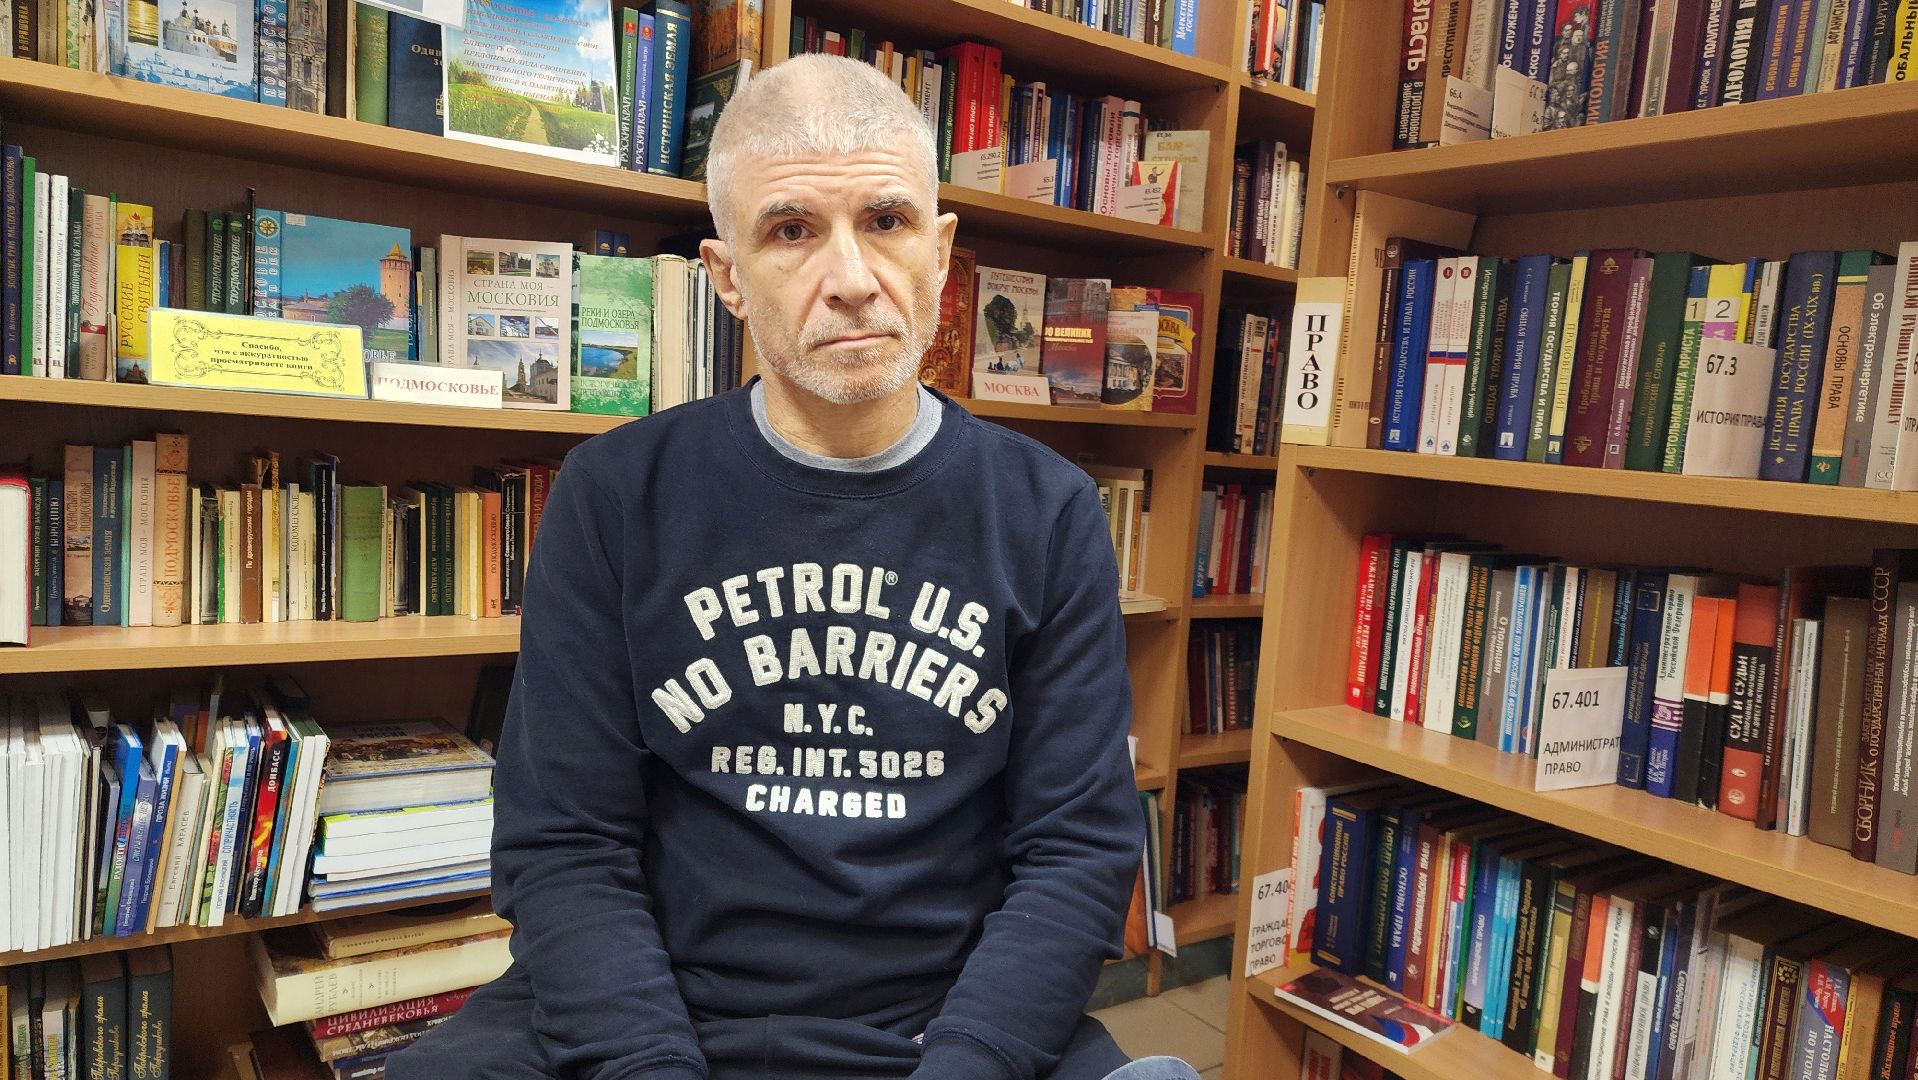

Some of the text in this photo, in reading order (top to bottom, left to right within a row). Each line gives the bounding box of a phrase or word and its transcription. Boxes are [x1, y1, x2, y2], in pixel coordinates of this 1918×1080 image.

[1435, 4, 1449, 57] ВОЕННЫЕ
[1442, 1, 1459, 78] ПРЕСТУПЛЕНИЯ
[1765, 4, 1789, 91] ОСНОВЫ ПОЛИТОЛОГИИ
[1788, 1, 1811, 87] ОСНОВЫ ПОЛИТОЛОГИИ
[660, 23, 678, 164] ИСТРИНСКАЯ ЗЕМЛЯ
[7, 156, 16, 288] ЗОЛОТЫЕ РУКИ МАСТЕРОВ ПОДМОСКОВЬЯ
[138, 253, 150, 324] СВЯТЫНИ
[467, 291, 559, 307] МОСКОВИЯ
[473, 279, 544, 291] СТРАНА МОЯ
[1406, 268, 1417, 299] РОССИИ
[1715, 299, 1732, 319] 2
[120, 281, 134, 348] РУССКИЕ
[582, 307, 635, 320] РЕКИ И ОЗЕРА
[582, 318, 639, 329] ПОДМОСКОВЬЯ
[1402, 301, 1414, 325] ПРАВА
[1803, 297, 1821, 339] (IX-XIX
[210, 356, 284, 367] просматриваете
[240, 350, 309, 361] аккуратностью
[241, 341, 282, 352] Спасибо,
[1297, 314, 1329, 410] ПРАВО
[1395, 336, 1410, 387] ГОСУДАРСТВА
[1484, 296, 1509, 424] ОБЩАЯ ТЕОРИЯ ПРАВА
[1533, 291, 1561, 440] ТЕОРИЯ ГОСУДАРСТВА И ПРАВА
[1577, 295, 1604, 415] Проблемы общей теории
[1706, 354, 1737, 376] 67.3
[1793, 344, 1812, 393] РОССИИ
[1828, 326, 1851, 410] ОСНОВЫ ПРАВА
[1855, 292, 1884, 422] Об электроэнергетике
[377, 377, 499, 395] ПОДМОСКОВЬЕ
[984, 381, 1040, 398] МОСКВА
[1643, 341, 1666, 448] ЮРИДИЧЕСКИЙ СЛОВАРЬ
[1663, 327, 1695, 467] НАСТОЛЬНАЯ КНИГА ЮРИСТА
[1769, 305, 1801, 452] ИСТОРИЯ ГОСУДАРСТВА
[1391, 389, 1404, 424] ИСТОРИЯ
[1696, 410, 1740, 424] ИСТОРИЯ
[1788, 399, 1803, 437] ПРАВА
[1785, 443, 1797, 452] И
[66, 489, 77, 532] МОНАСТЫРИ
[79, 482, 91, 532] ПОДМОСКОВЬЯ
[164, 478, 181, 578] ПОДМОСКОВЬЕ
[139, 477, 150, 594] СТРАНА МОЯ МОСКОВИЯ
[100, 530, 113, 612] Одинцовская земля
[245, 560, 253, 569] По
[429, 557, 438, 603] АБРАМЦЕВО
[444, 557, 453, 603] АБРАМЦЕВО
[1365, 551, 1378, 611] ГРАЖДАНСТВО
[1872, 567, 1891, 612] СССР
[910, 581, 989, 658] U.S.
[1658, 589, 1676, 681] Административное право
[1668, 593, 1685, 679] Российской Федерации
[1874, 613, 1889, 659] НАГРАДАХ
[1356, 625, 1370, 683] РЕГИСТРАЦИЯ
[1505, 584, 1527, 736] ИЗБИРАТЕЛЬНОЕ ПРАВО РОССИЙСКОЙ ФЕДЕРАЦИИ
[651, 626, 1008, 735] NO BARRIERS
[1552, 690, 1600, 710] 67.401
[1729, 654, 1749, 740] СУД И СУДЬИ
[1870, 662, 1887, 748] ГОСУДАРСТВЕННЫХ
[784, 703, 874, 736] N.Y.C.
[267, 750, 281, 793] ДОНБАСС
[711, 745, 946, 779] REG. INT. 5026
[1545, 761, 1581, 775] ПРАВО
[745, 783, 907, 819] CHARGED
[1854, 758, 1878, 842] СБОРНИК
[168, 810, 190, 890] Евгений КАРАСЕВ
[1328, 820, 1344, 904] КОНСТИТУЦИОННОЕ
[1339, 832, 1350, 898] ПРАВО РОССИИ
[1258, 879, 1288, 901] 67.40
[1373, 826, 1394, 955] ТРАНСПОРТНОЕ ПРАВО
[1391, 867, 1408, 948] ОСНОВЫ ПРАВА
[1411, 841, 1431, 956] ПРЕДПРИНИМАТЕЛЬСКОЕ ПРАВО
[1249, 954, 1276, 969] ПРАВО
[95, 996, 108, 1023] храма
[140, 991, 152, 1018] храма
[327, 1005, 439, 1036] СРЕДНЕВЕКОВЬЯ
[328, 997, 434, 1027] ЦИВИЛИЗАЦИЯ
[1668, 970, 1687, 1051] Семейное право
[1880, 1001, 1901, 1079] Жилищное право
